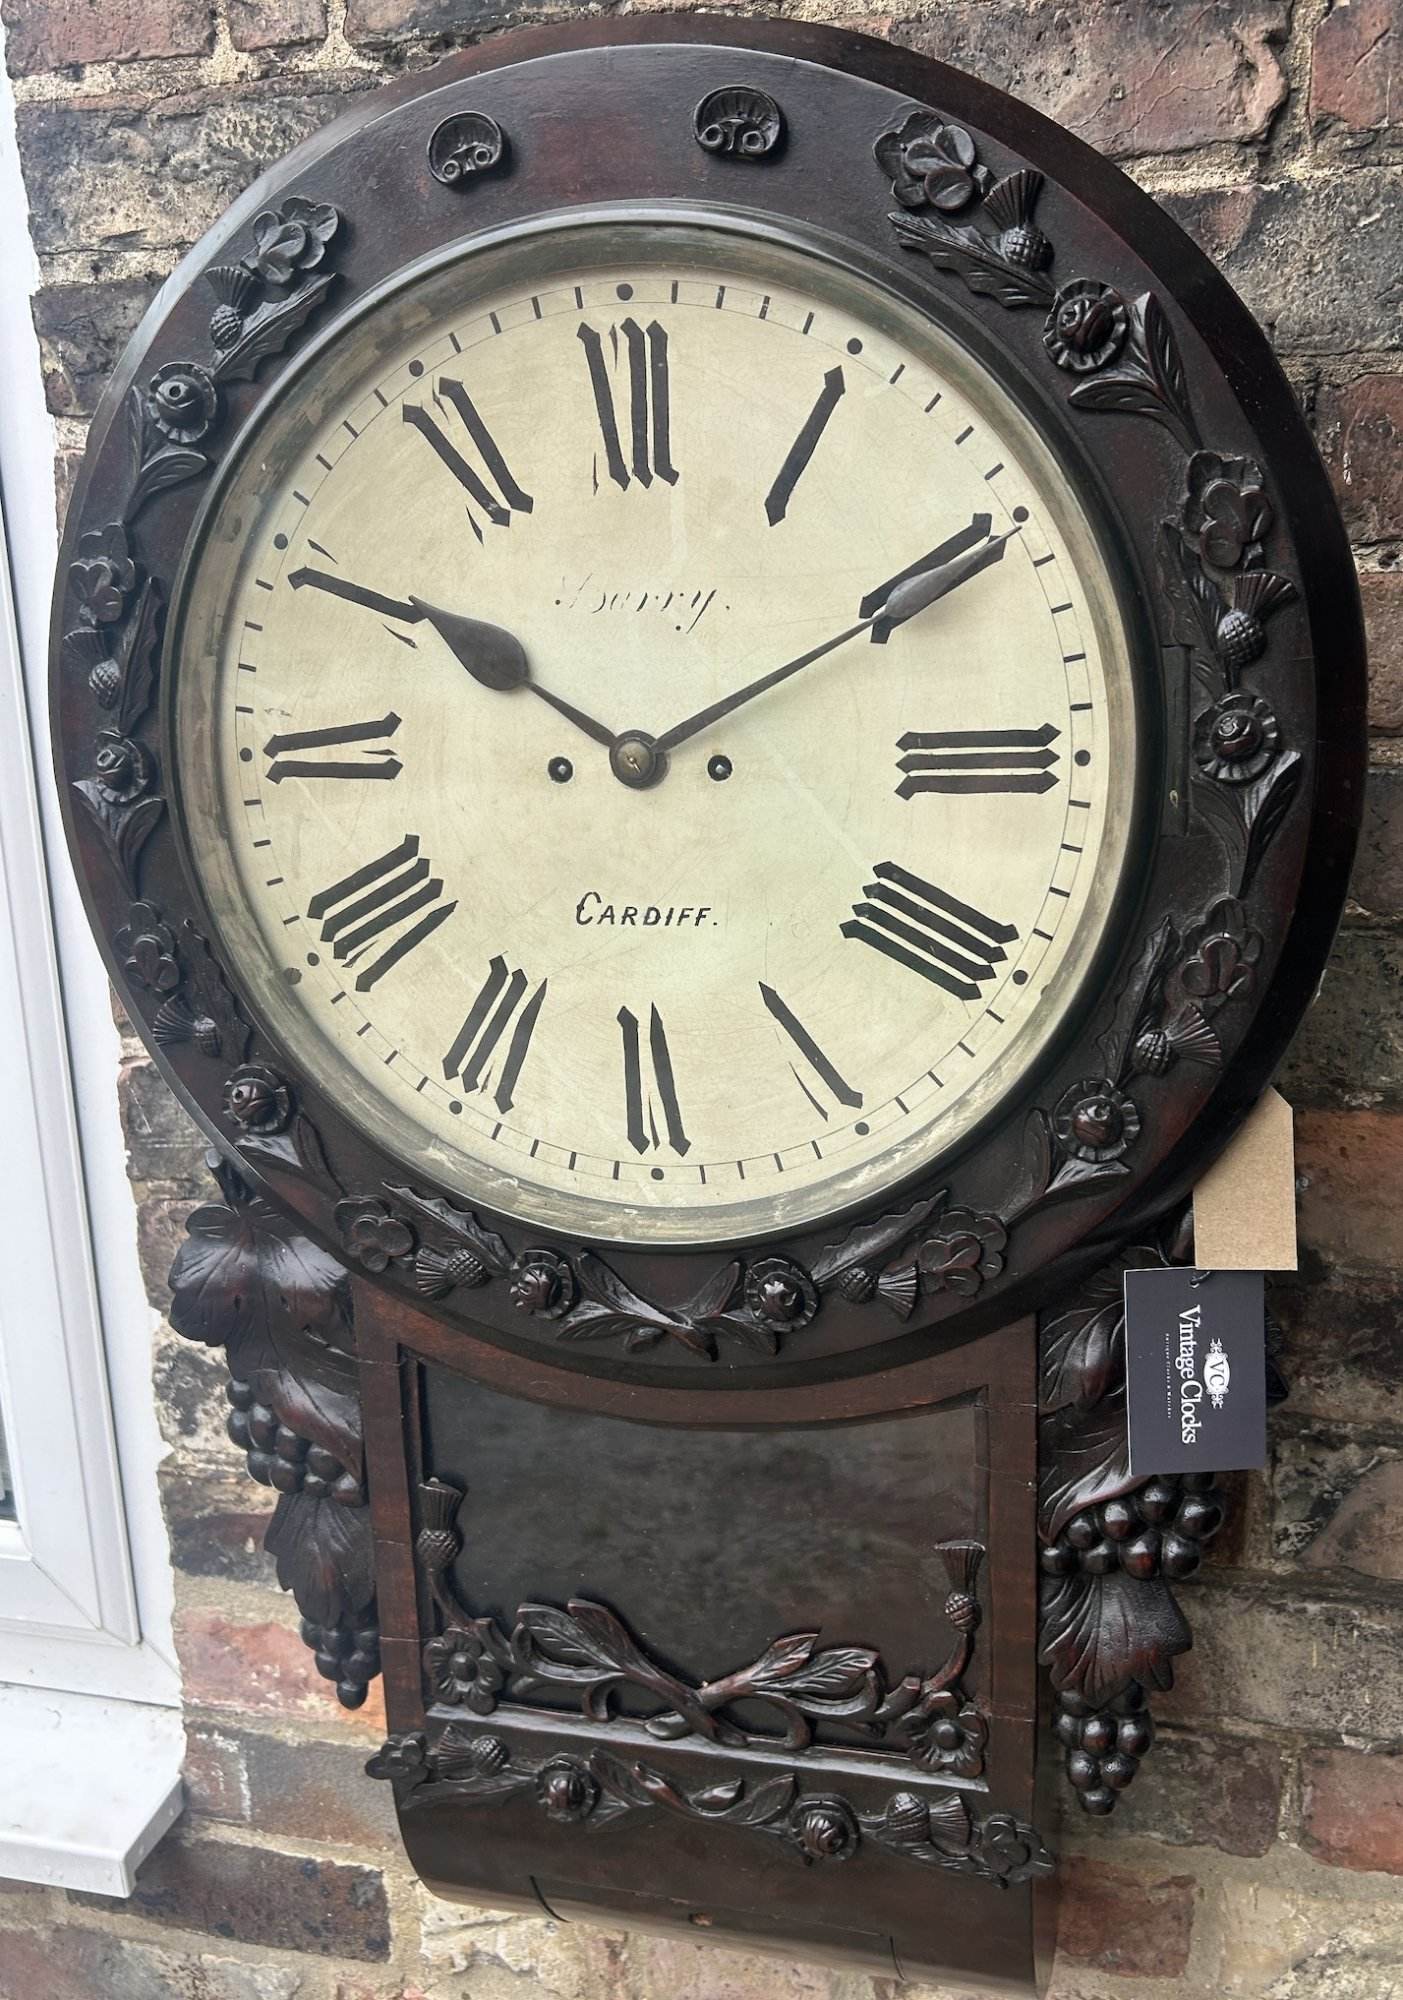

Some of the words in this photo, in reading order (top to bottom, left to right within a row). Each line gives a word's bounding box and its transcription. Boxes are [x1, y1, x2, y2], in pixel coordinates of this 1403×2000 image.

[764, 365, 846, 527] I
[894, 722, 1062, 800] III
[839, 861, 1020, 1001] IIII
[1175, 1304, 1201, 1379] Vintage
[1209, 1361, 1225, 1387] VC
[1181, 1380, 1203, 1444] Clocks
